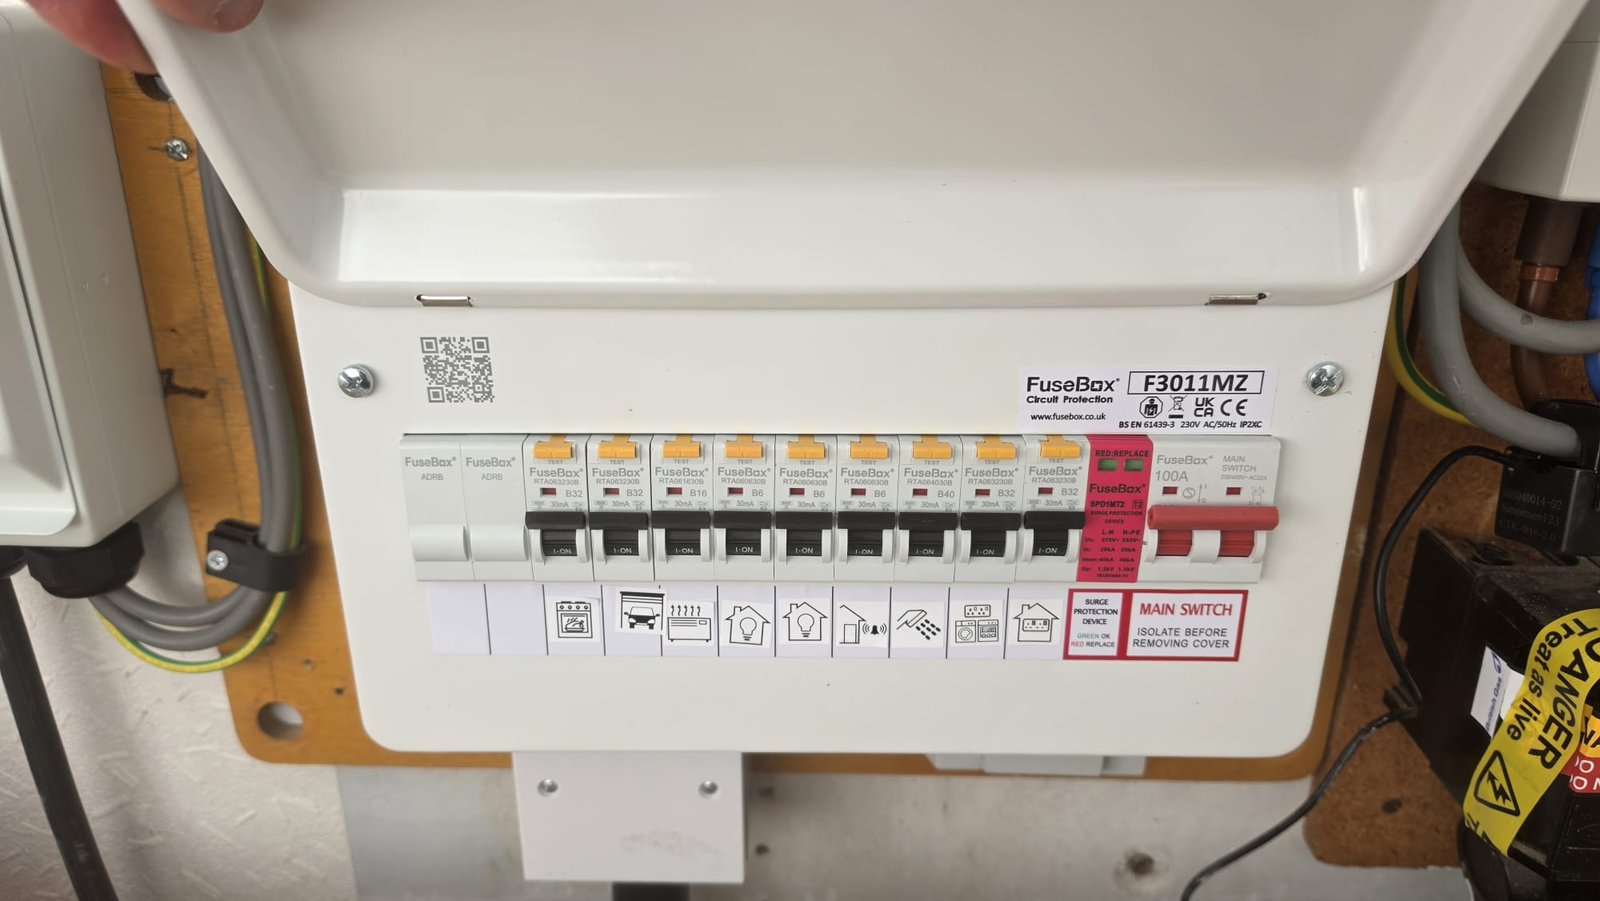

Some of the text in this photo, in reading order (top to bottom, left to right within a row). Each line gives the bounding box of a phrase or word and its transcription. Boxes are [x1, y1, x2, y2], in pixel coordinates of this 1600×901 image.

[1144, 374, 1249, 392] F3011MZ
[1027, 396, 1113, 404] Circuit Protection
[1030, 412, 1106, 421] www.fusebox.co.uk
[1204, 421, 1236, 429] AC/50Hz
[1155, 471, 1189, 482] 100A
[566, 489, 583, 498] B32
[626, 489, 643, 497] B32
[998, 489, 1015, 497] B32
[1061, 488, 1079, 496] B32
[1140, 603, 1233, 616] MAIN SWITCH
[1137, 628, 1228, 637] ISOLATE BEFORE
[1133, 639, 1230, 648] REMOVING COVER
[1506, 618, 1598, 741] Treat as live
[1485, 676, 1502, 732] British Gas
